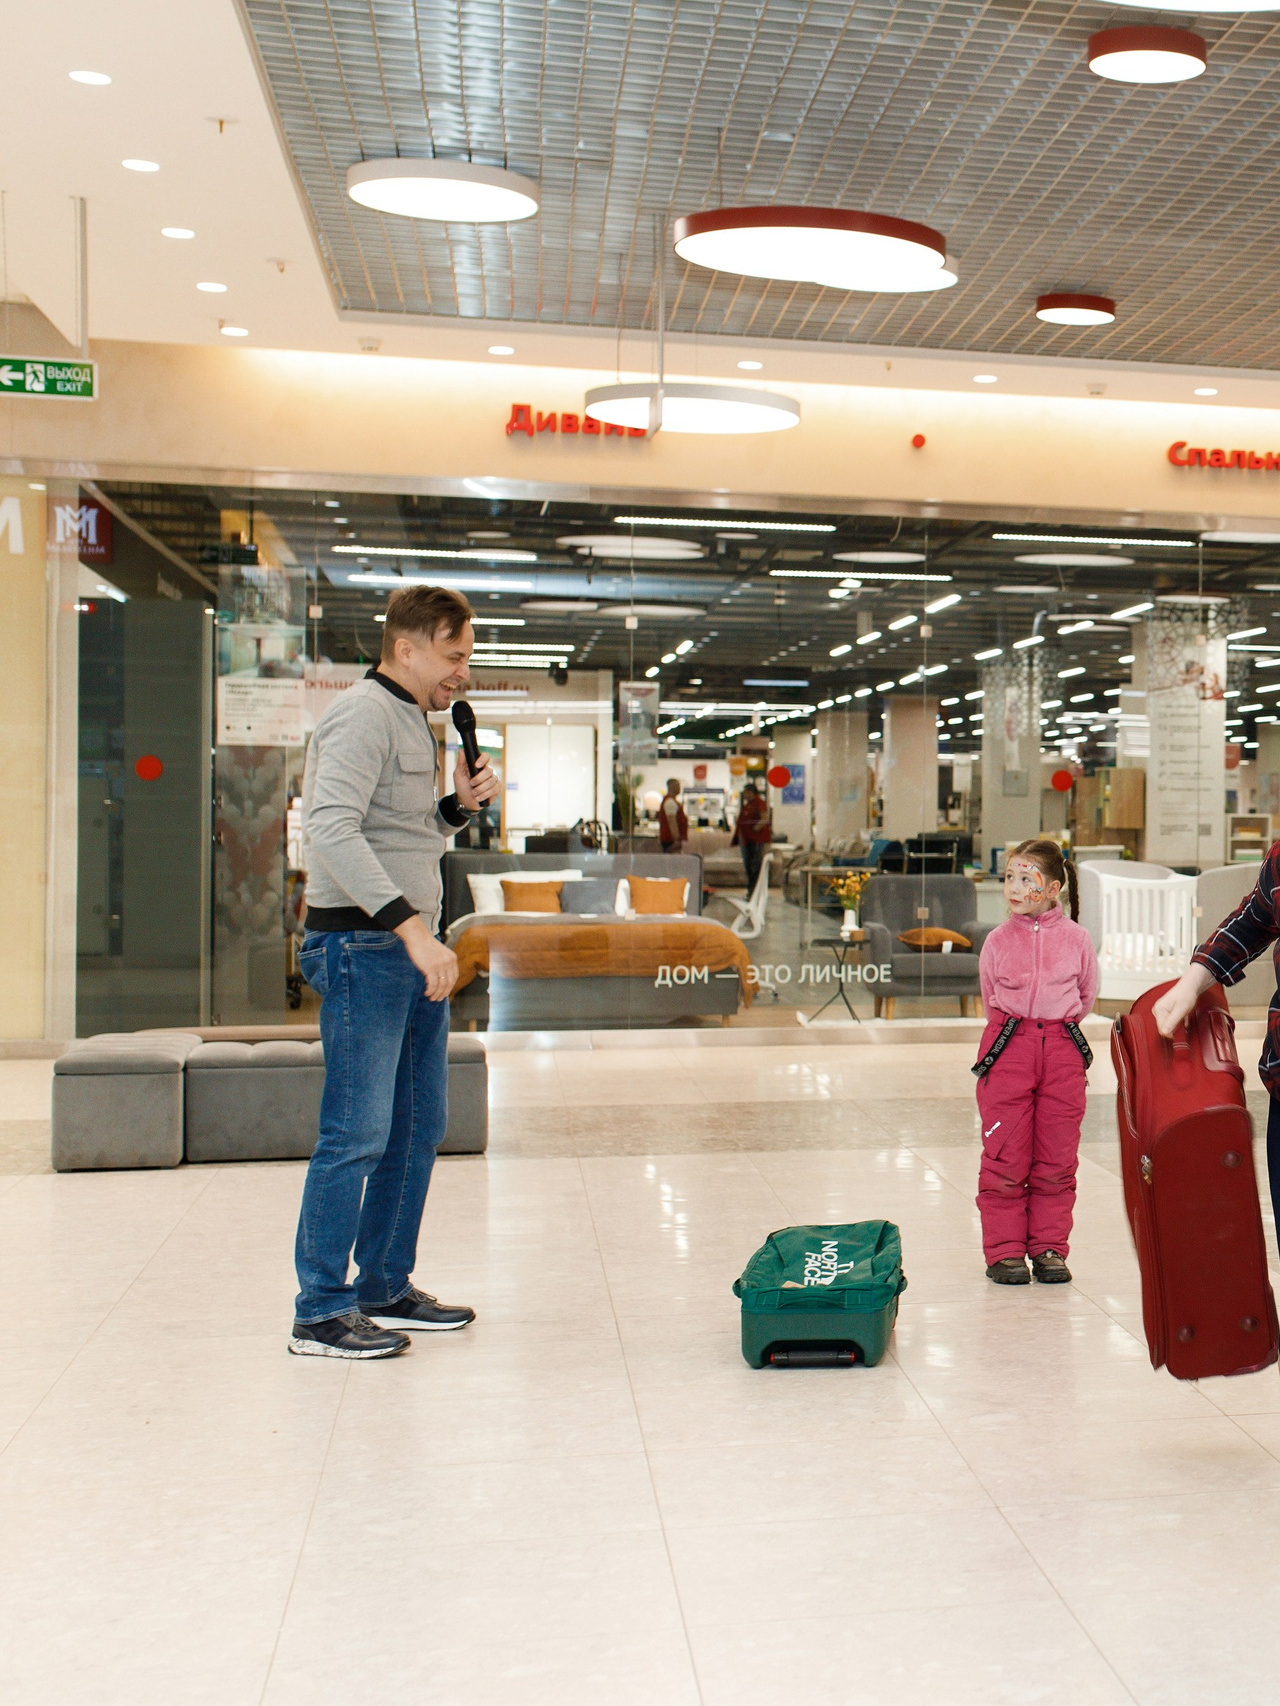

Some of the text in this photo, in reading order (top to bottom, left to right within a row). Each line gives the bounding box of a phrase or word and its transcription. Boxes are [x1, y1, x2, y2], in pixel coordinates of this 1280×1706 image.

[46, 365, 92, 384] ВЫХОД
[56, 381, 83, 393] EXIT
[654, 965, 709, 988] ДОМ
[746, 965, 792, 984] ЭТО
[798, 964, 893, 984] ЛИЧНОЕ
[803, 1251, 822, 1286] FACE
